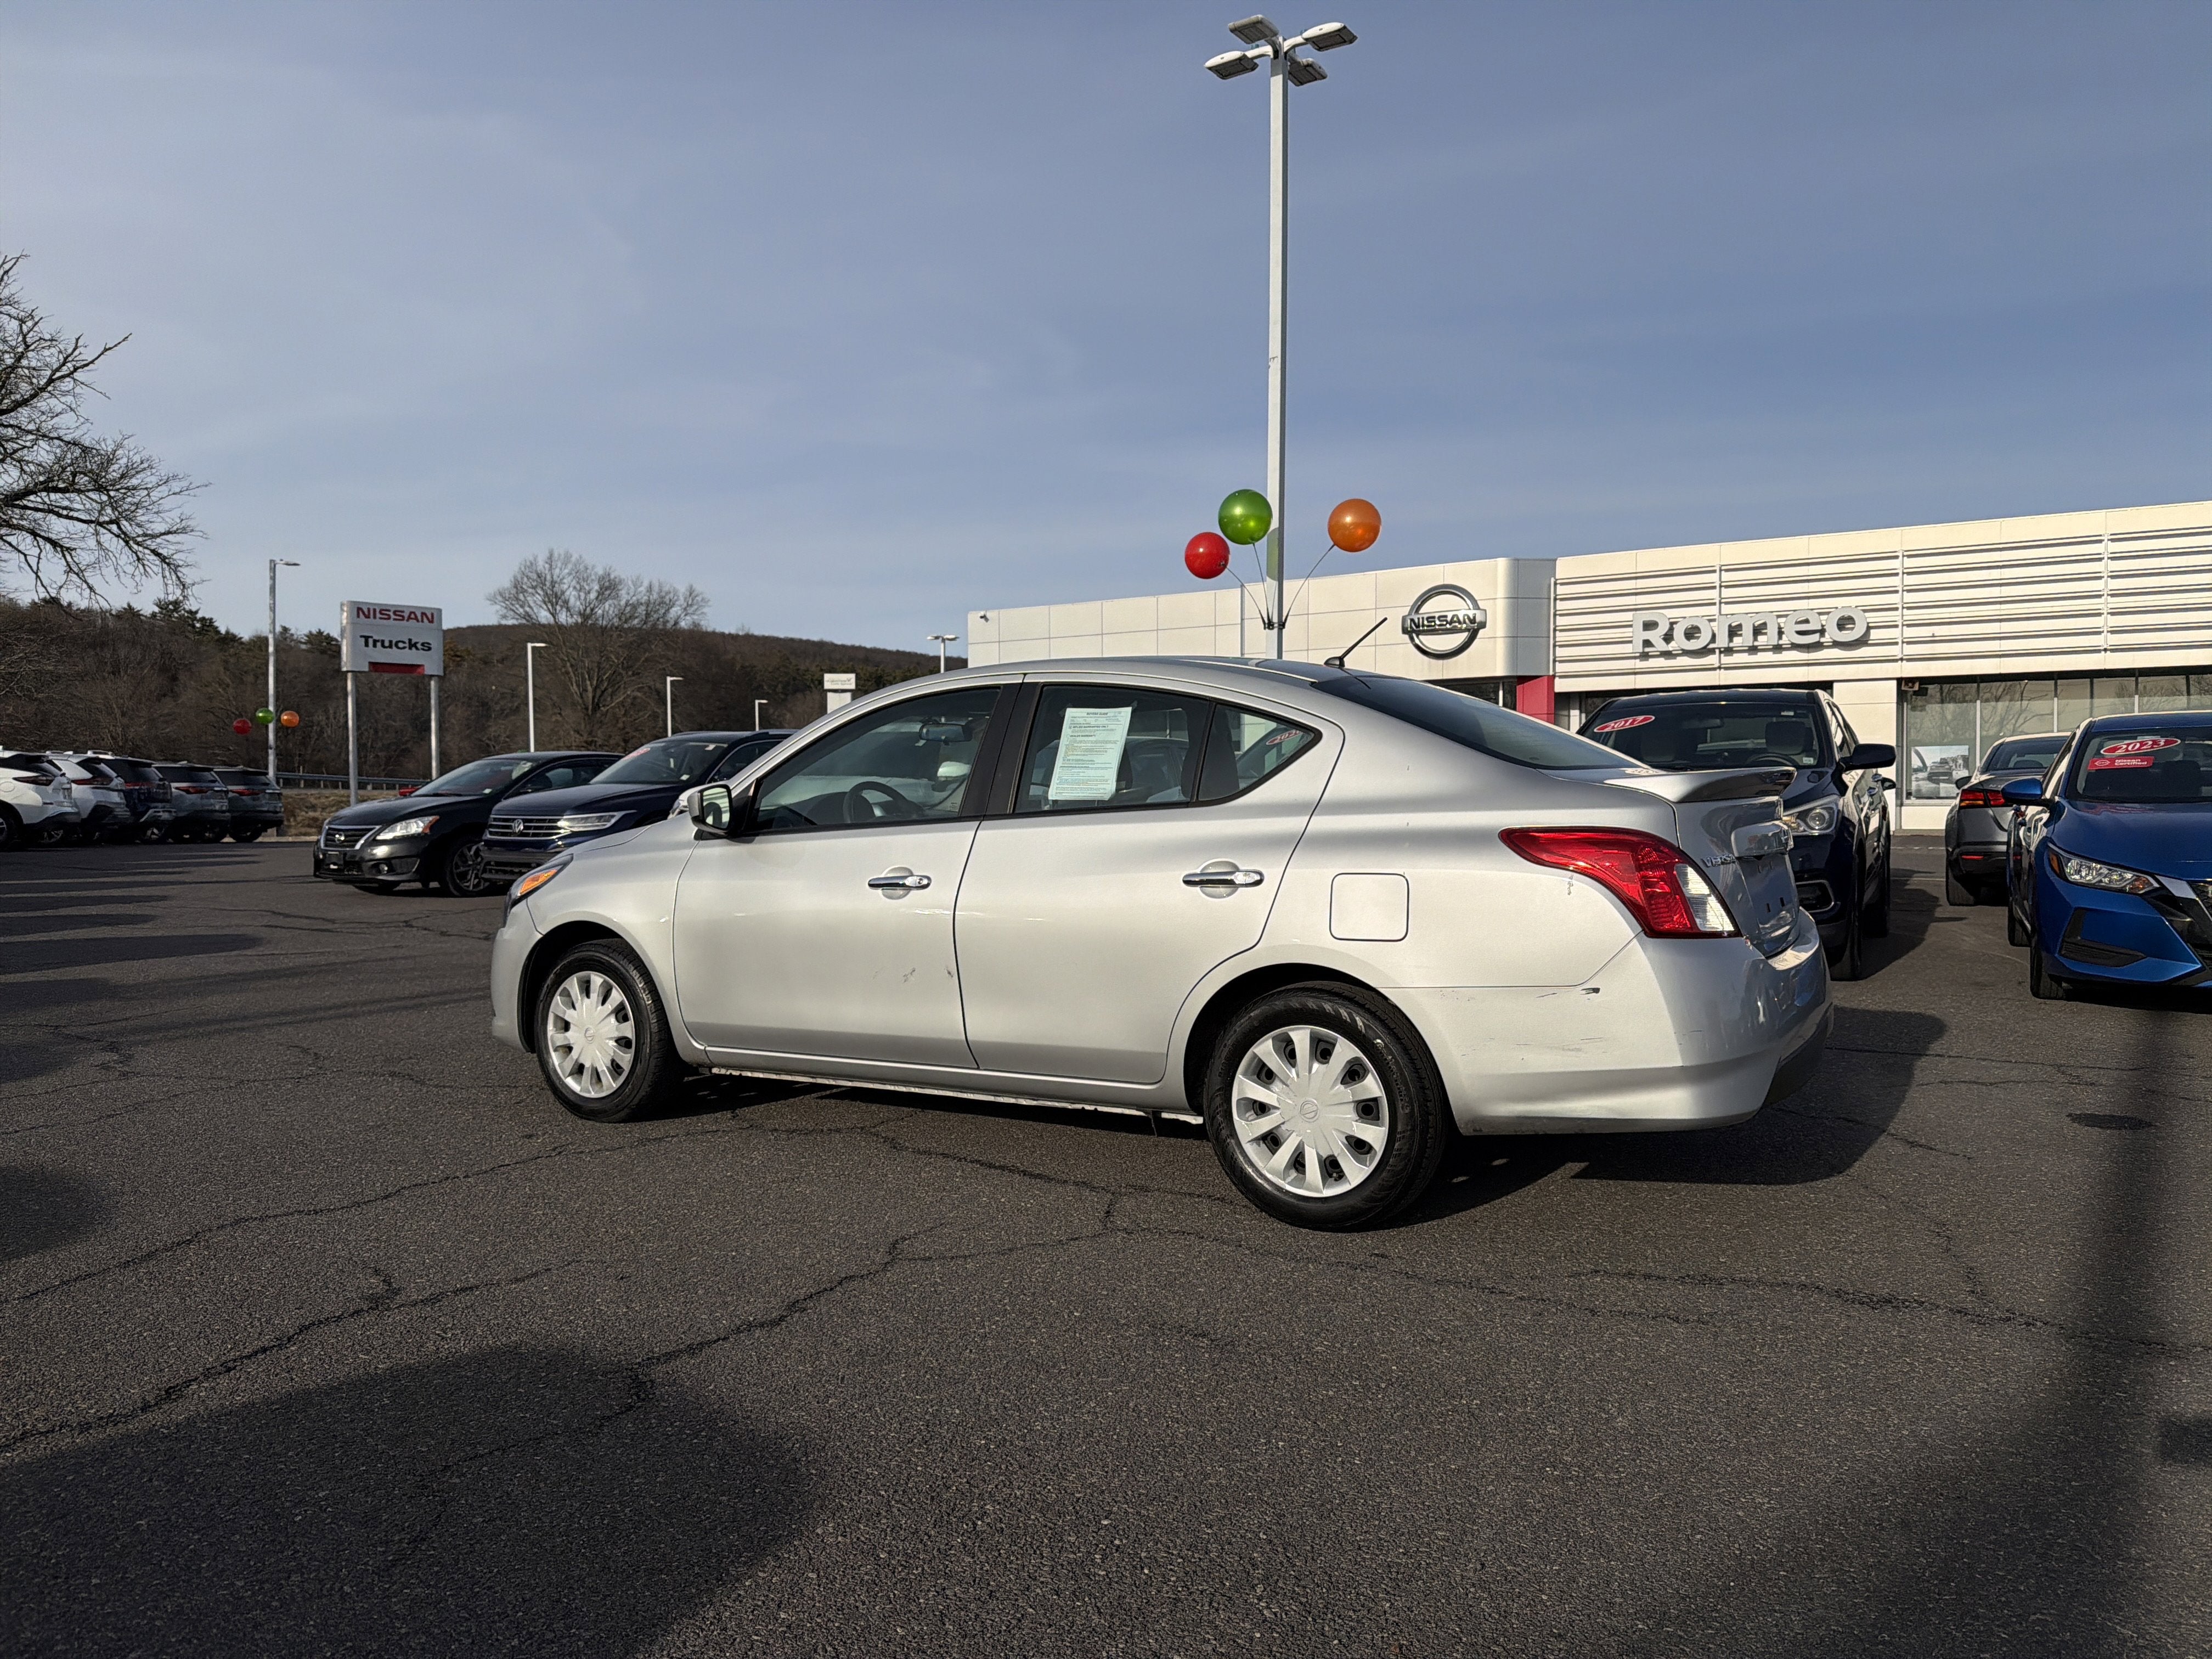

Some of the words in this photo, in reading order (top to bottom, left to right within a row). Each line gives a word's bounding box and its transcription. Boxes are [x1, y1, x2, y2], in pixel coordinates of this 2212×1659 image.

[357, 607, 435, 624] NISSAN
[1408, 613, 1477, 630] NISSAN
[1632, 607, 1868, 653] Romeo
[359, 635, 432, 651] Trucks
[1606, 716, 1644, 730] 2017
[2115, 739, 2166, 753] 2023
